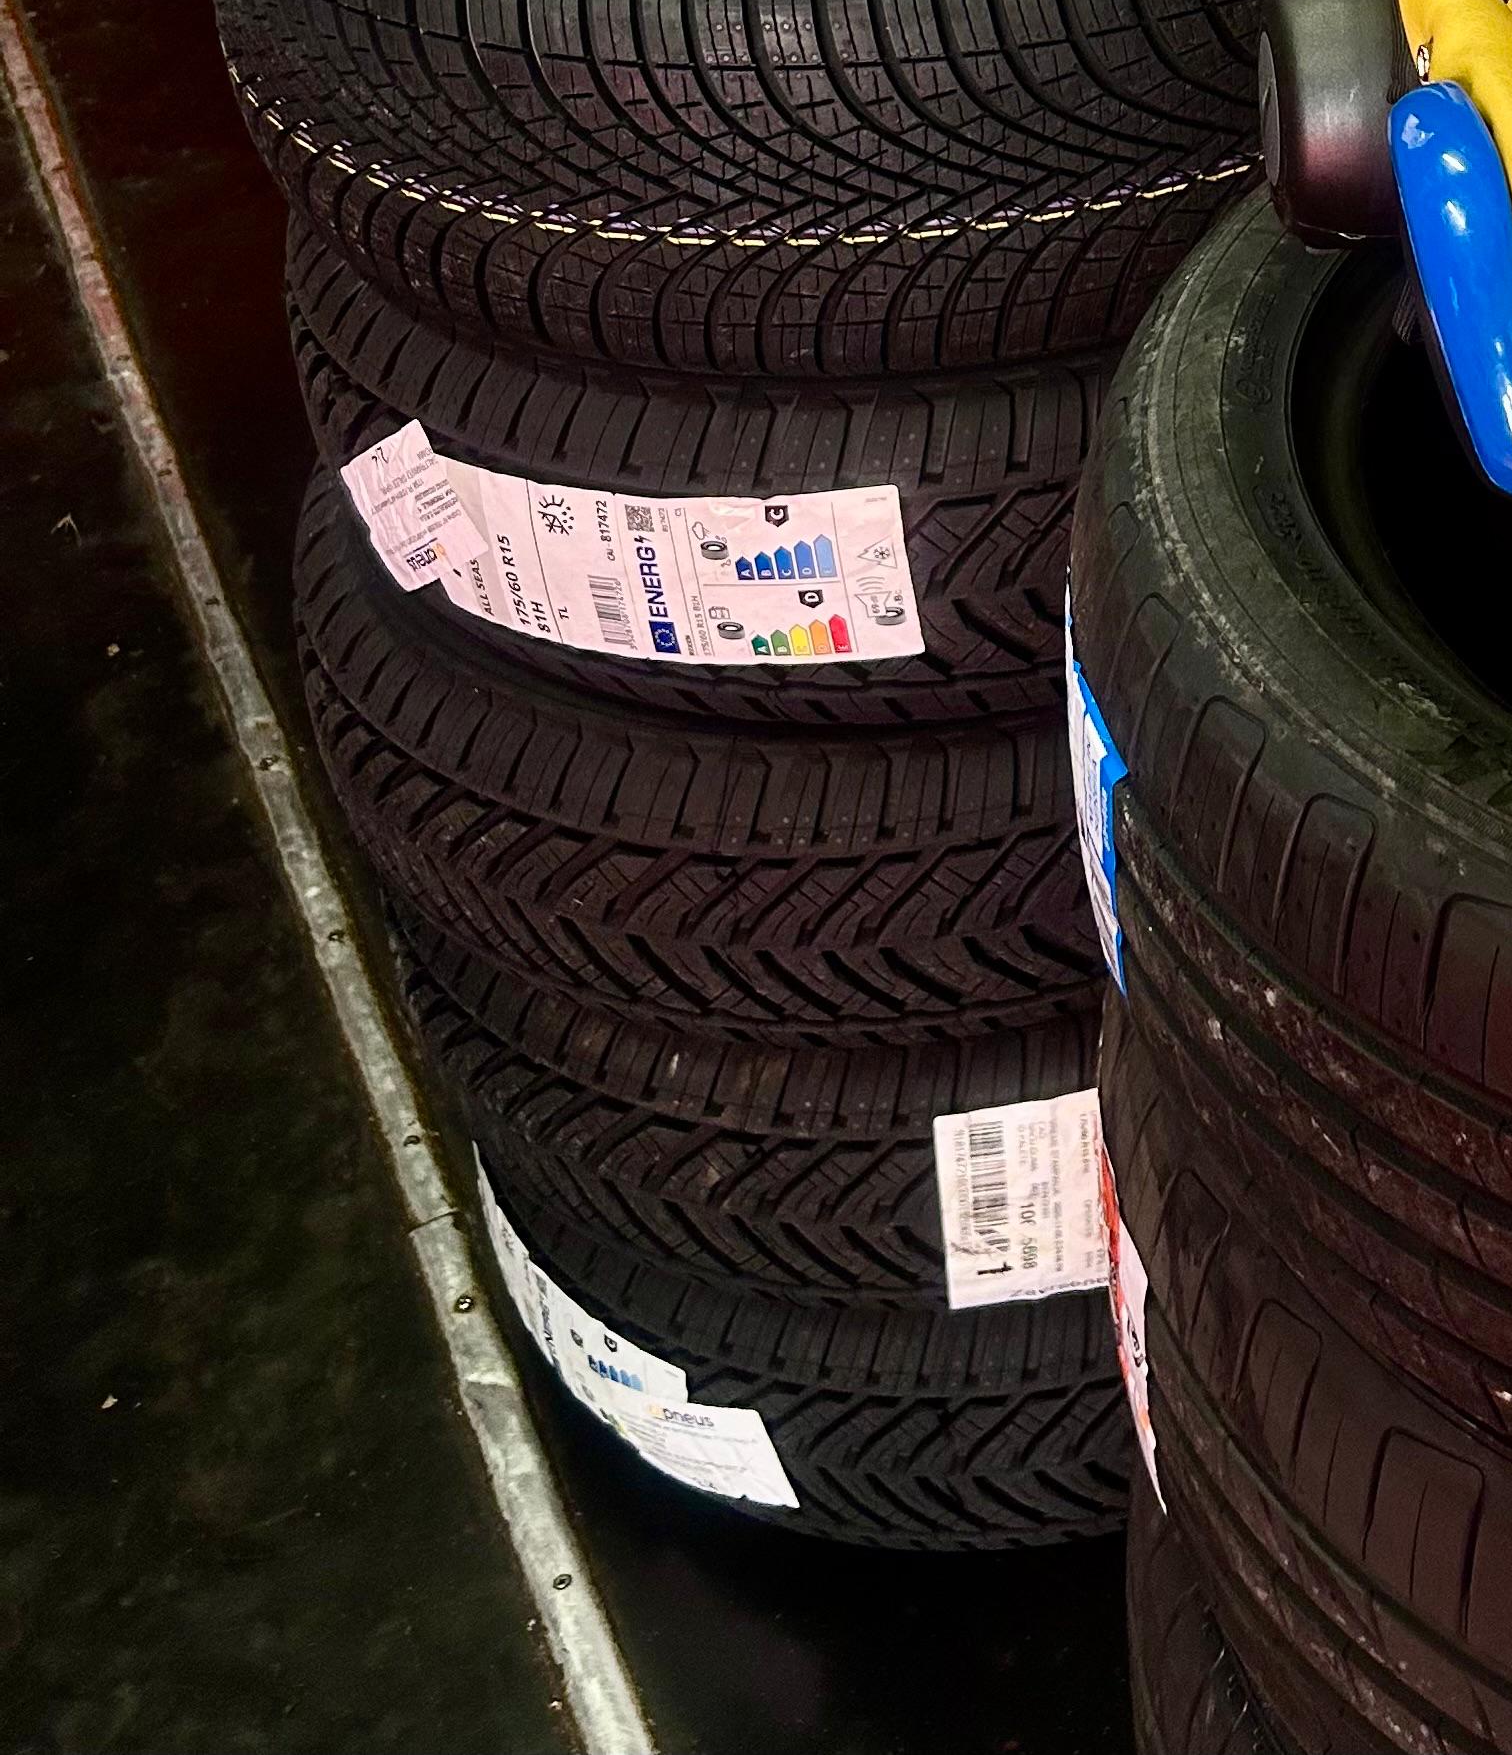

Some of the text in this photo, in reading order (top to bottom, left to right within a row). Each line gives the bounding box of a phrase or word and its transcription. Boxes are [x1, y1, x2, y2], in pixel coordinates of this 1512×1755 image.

[596, 499, 612, 542] 817472
[770, 507, 784, 521] C
[497, 534, 533, 626] 175/60 R15
[634, 545, 669, 618] ENERG
[741, 569, 750, 577] A
[781, 568, 791, 577] C
[480, 594, 495, 616] ALL
[803, 592, 817, 603] D
[530, 601, 550, 633] 81H
[559, 606, 570, 620] TL
